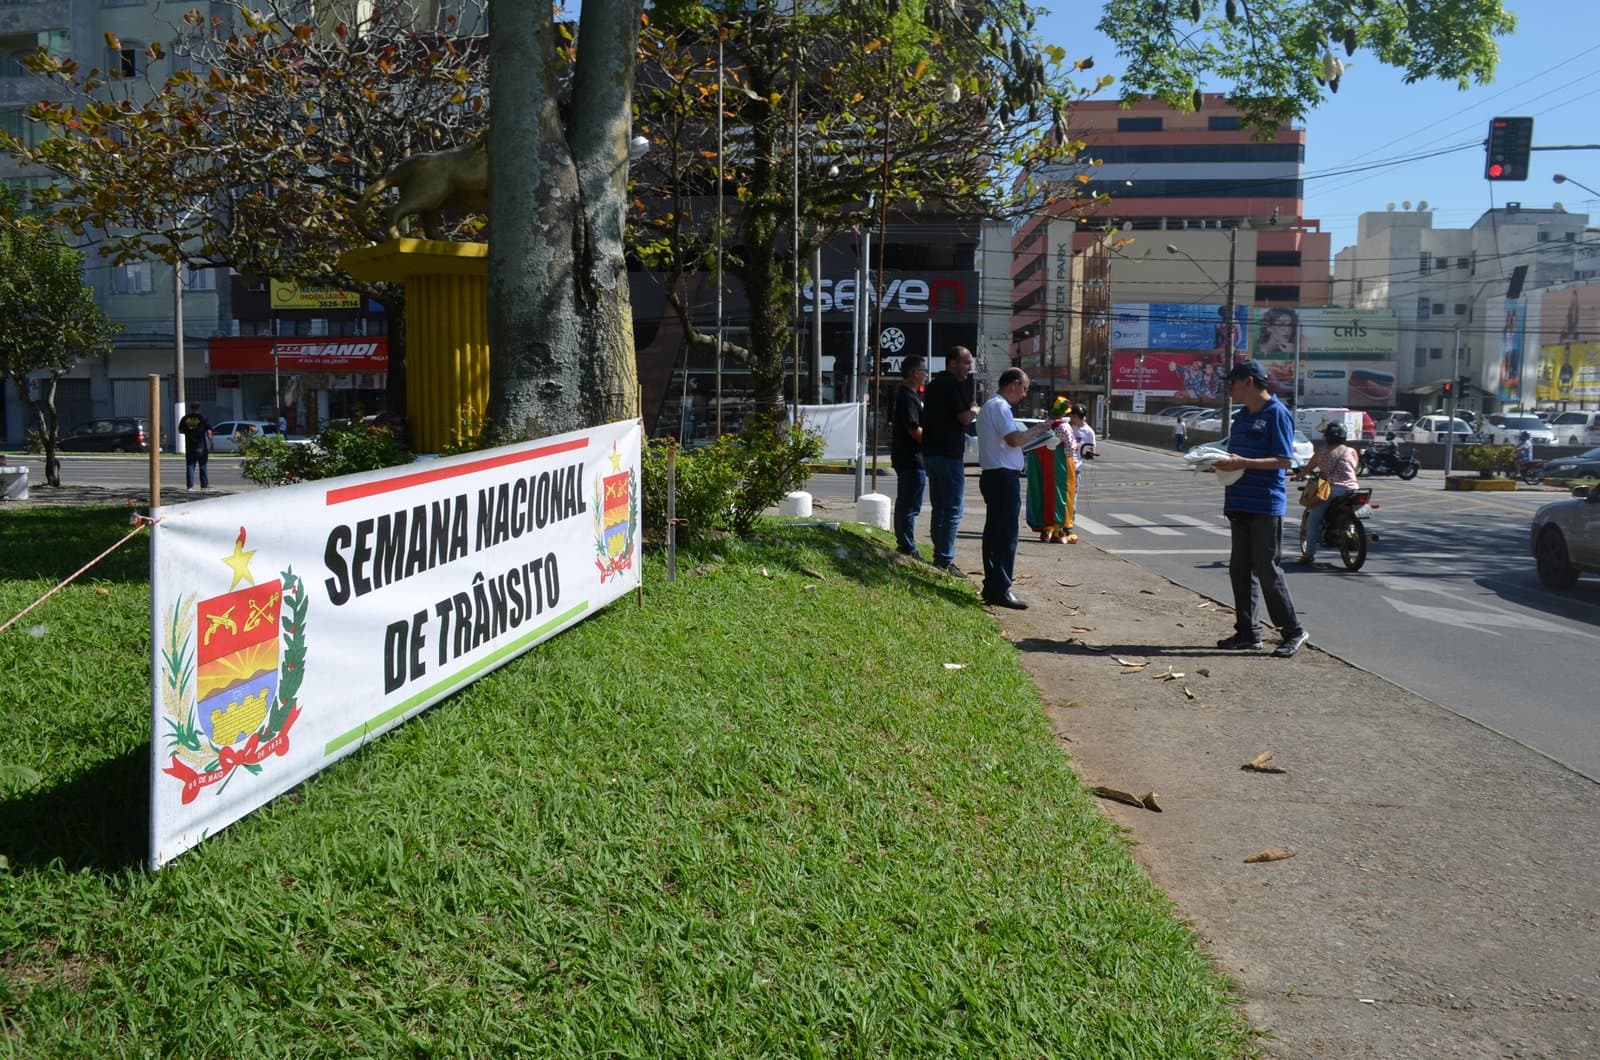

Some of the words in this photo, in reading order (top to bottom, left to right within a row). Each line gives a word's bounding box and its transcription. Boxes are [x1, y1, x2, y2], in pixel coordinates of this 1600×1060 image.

[1056, 242, 1067, 280] PARK
[802, 278, 964, 313] seven
[1055, 285, 1065, 342] CENTER
[324, 493, 469, 606] SEMANA
[475, 462, 587, 552] NACIONAL
[384, 608, 428, 696] DE
[435, 552, 560, 667] TRÂNSITO
[198, 776, 206, 785] DE
[208, 771, 224, 783] MAIO
